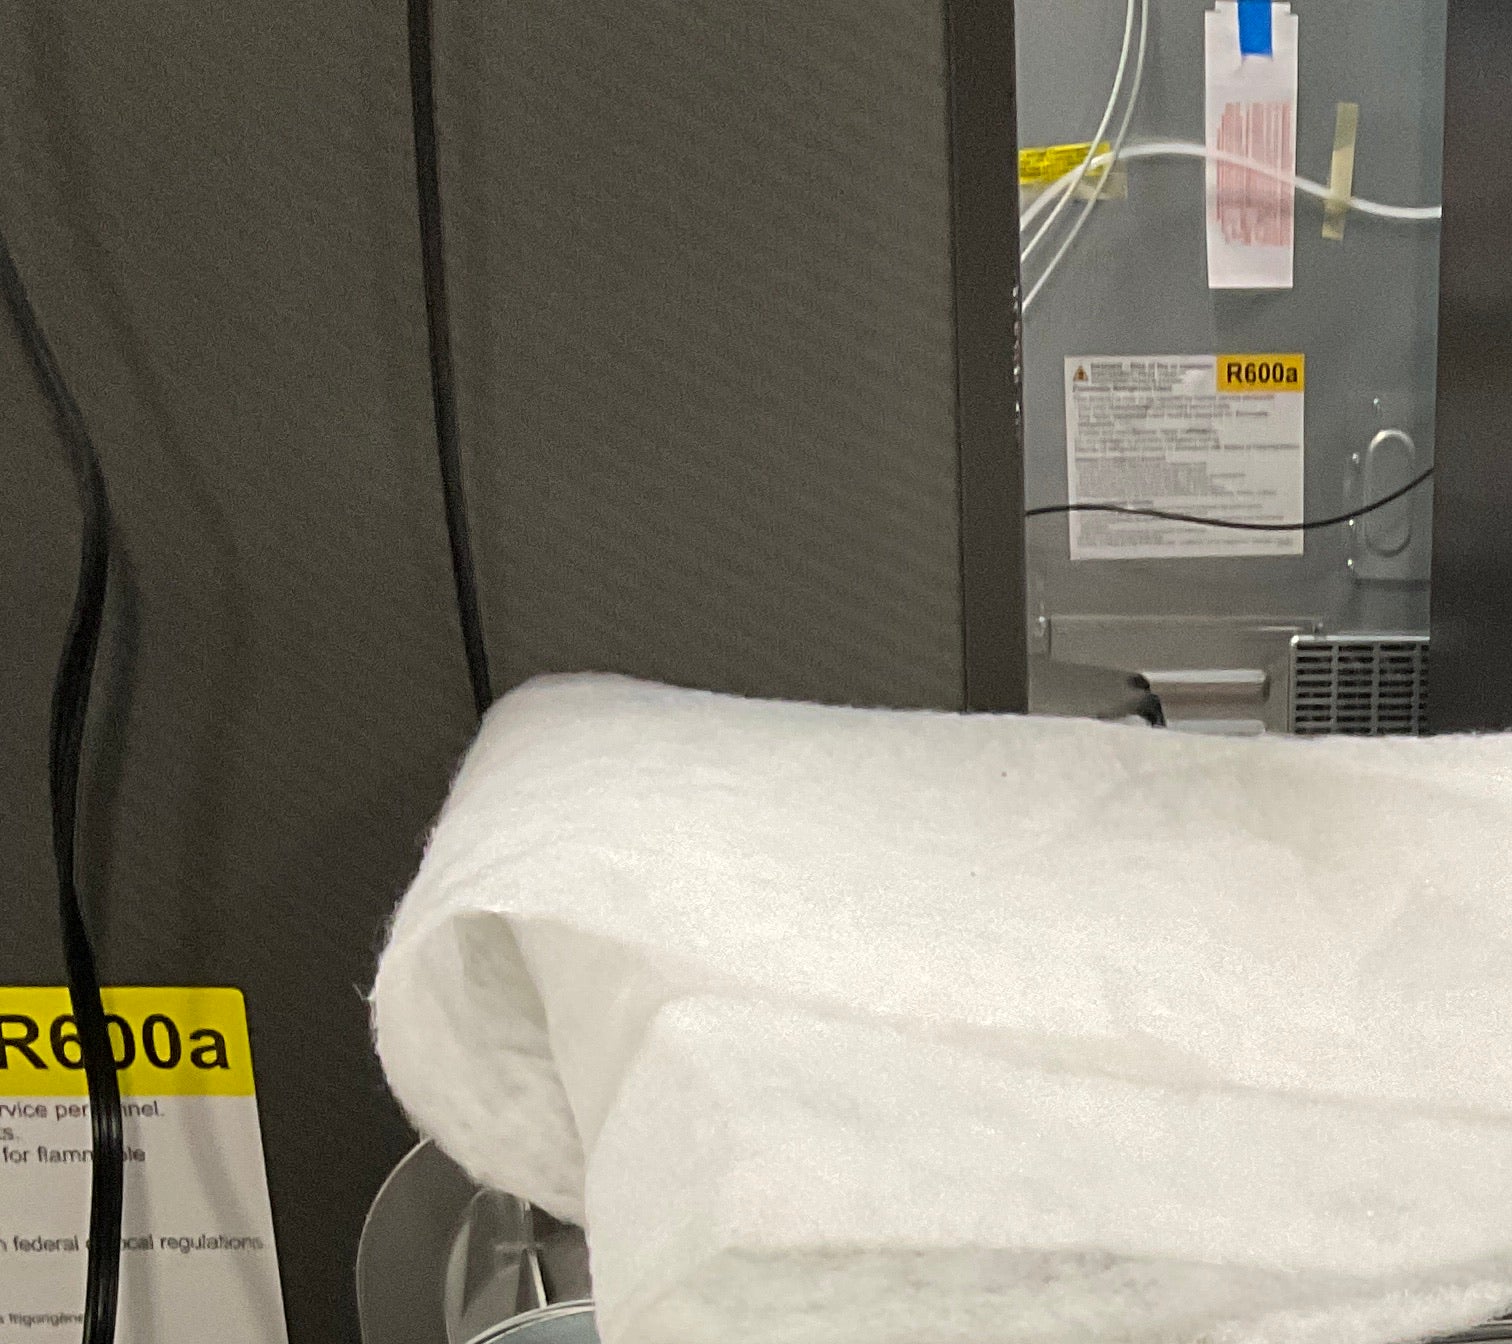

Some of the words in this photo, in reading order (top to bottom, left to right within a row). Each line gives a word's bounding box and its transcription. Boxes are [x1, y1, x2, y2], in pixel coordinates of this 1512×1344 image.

[1226, 362, 1298, 384] R600a
[3, 1146, 29, 1163] for
[13, 1235, 79, 1252] federal
